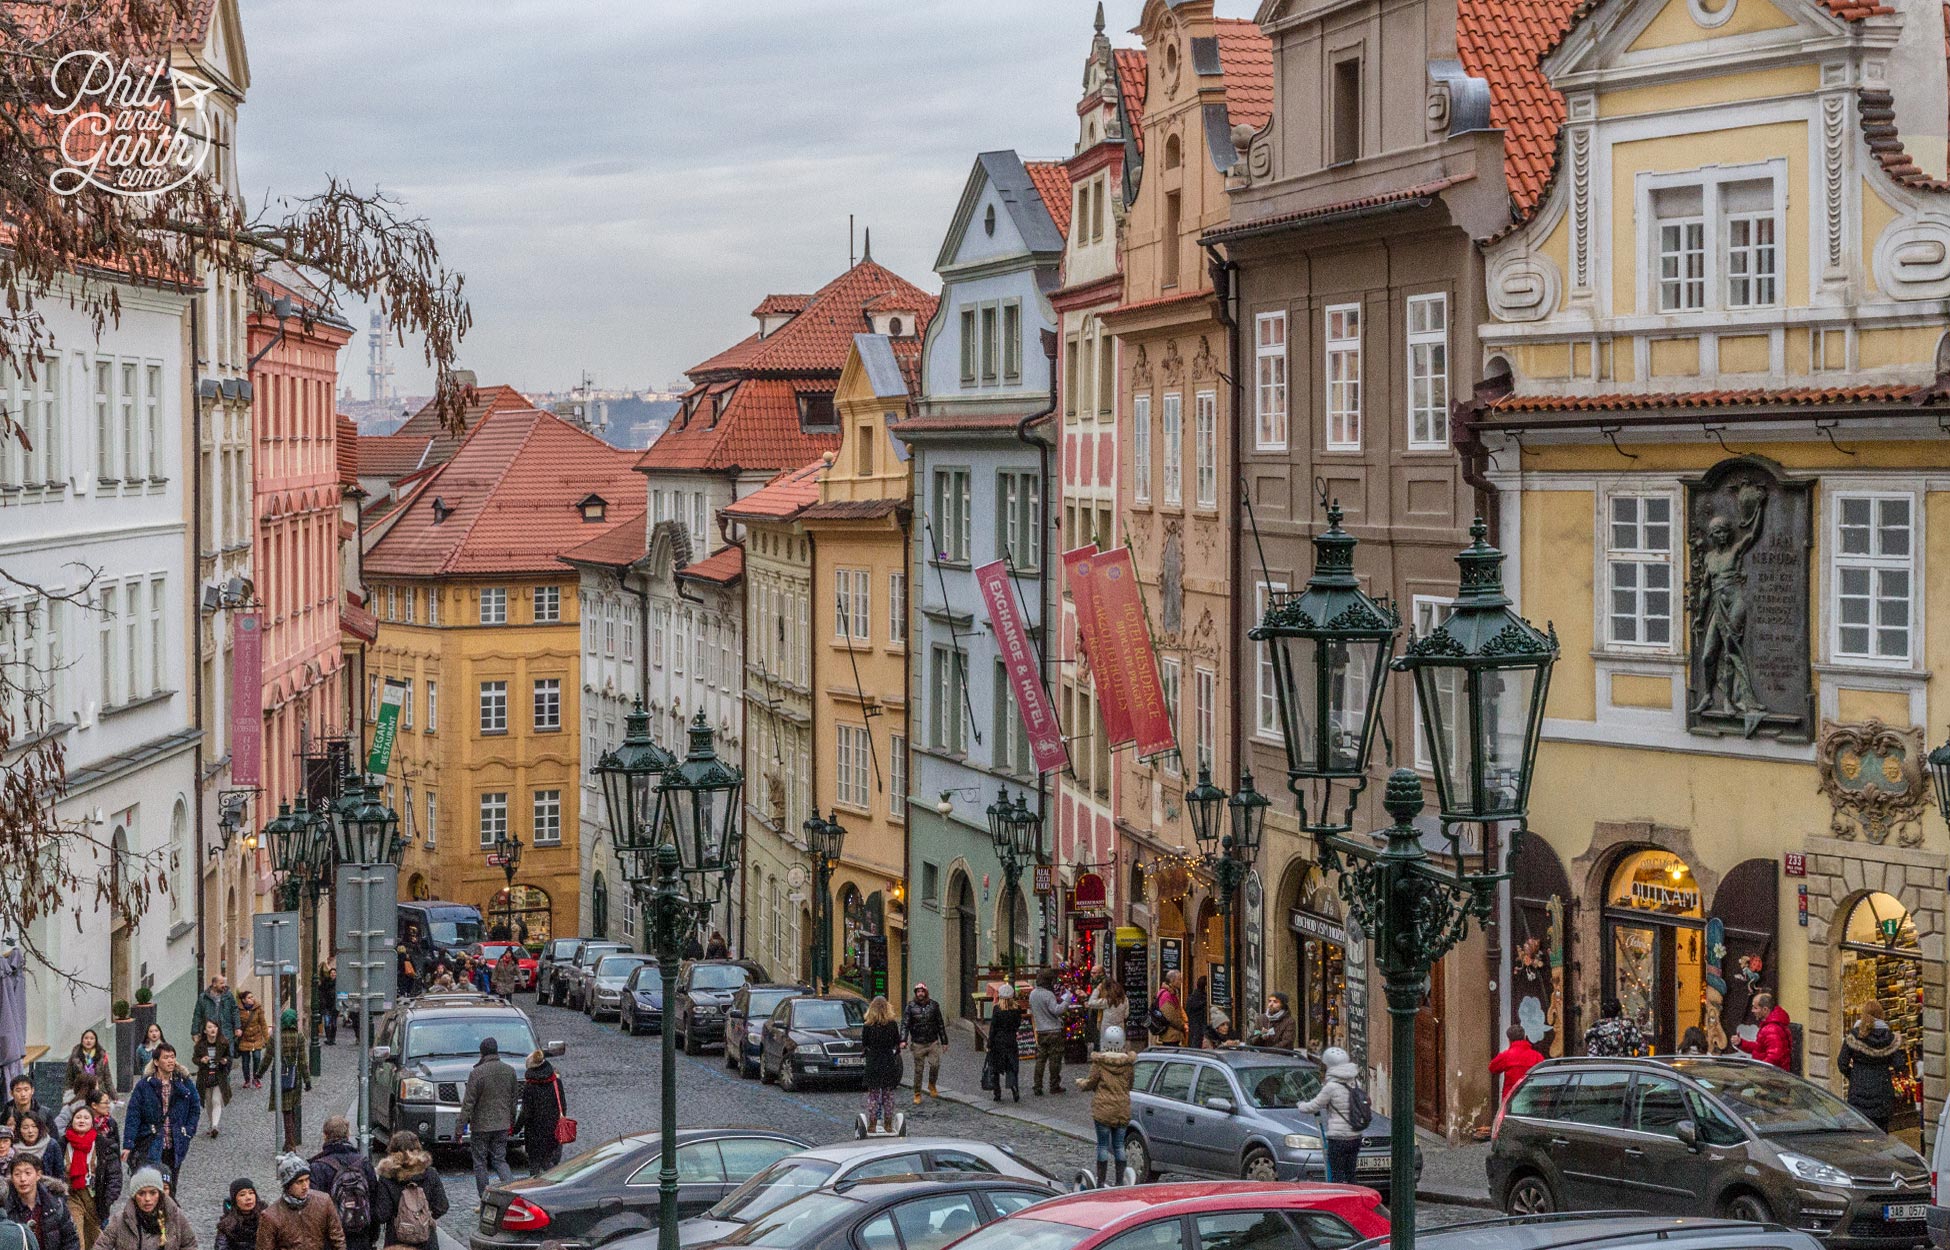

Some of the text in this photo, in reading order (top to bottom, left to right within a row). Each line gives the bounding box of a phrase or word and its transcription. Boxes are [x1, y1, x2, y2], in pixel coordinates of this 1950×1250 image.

[989, 580, 1044, 729] EXCHANGE & HOTEL
[1122, 602, 1161, 719] HOTEL RESIDENCE
[1127, 670, 1144, 709] PRAGUE
[372, 721, 387, 755] VEGAN
[380, 716, 397, 765] RESTAURANT
[1788, 854, 1802, 866] 233
[1621, 880, 1700, 909] LOUTKAMI
[1890, 1206, 1904, 1217] 3AB
